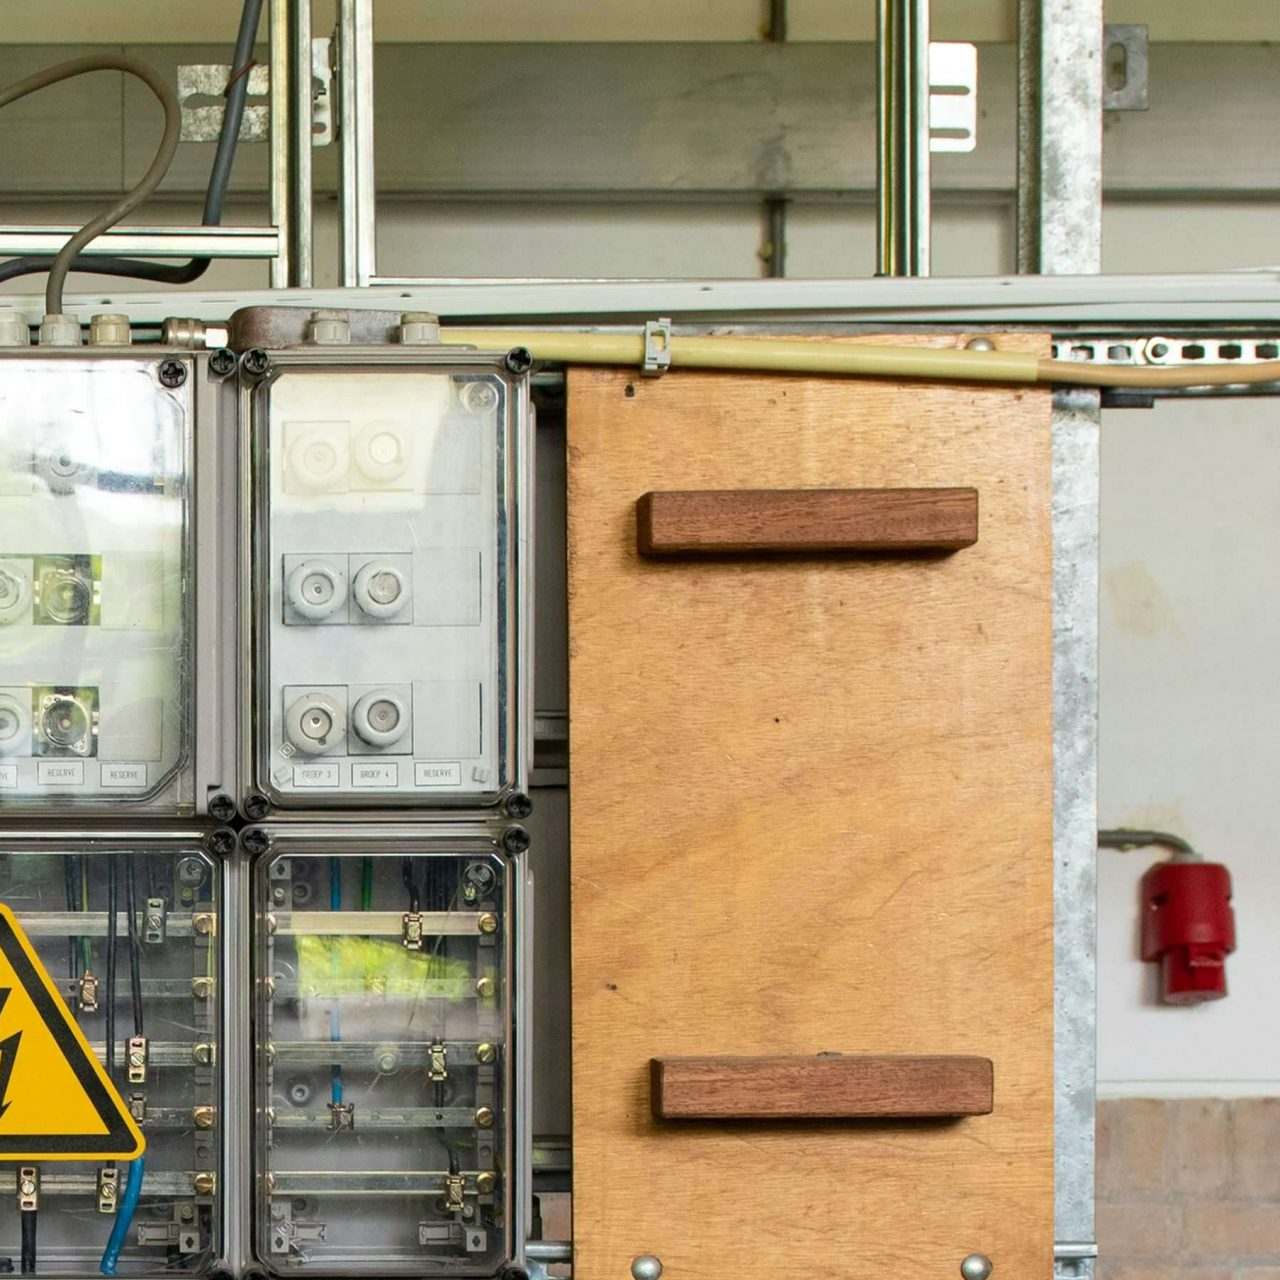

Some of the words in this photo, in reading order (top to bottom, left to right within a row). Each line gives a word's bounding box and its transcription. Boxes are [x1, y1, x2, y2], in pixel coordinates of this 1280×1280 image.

[47, 768, 76, 777] RESERVE
[109, 770, 138, 779] RESERVE
[423, 769, 453, 777] RESERVE
